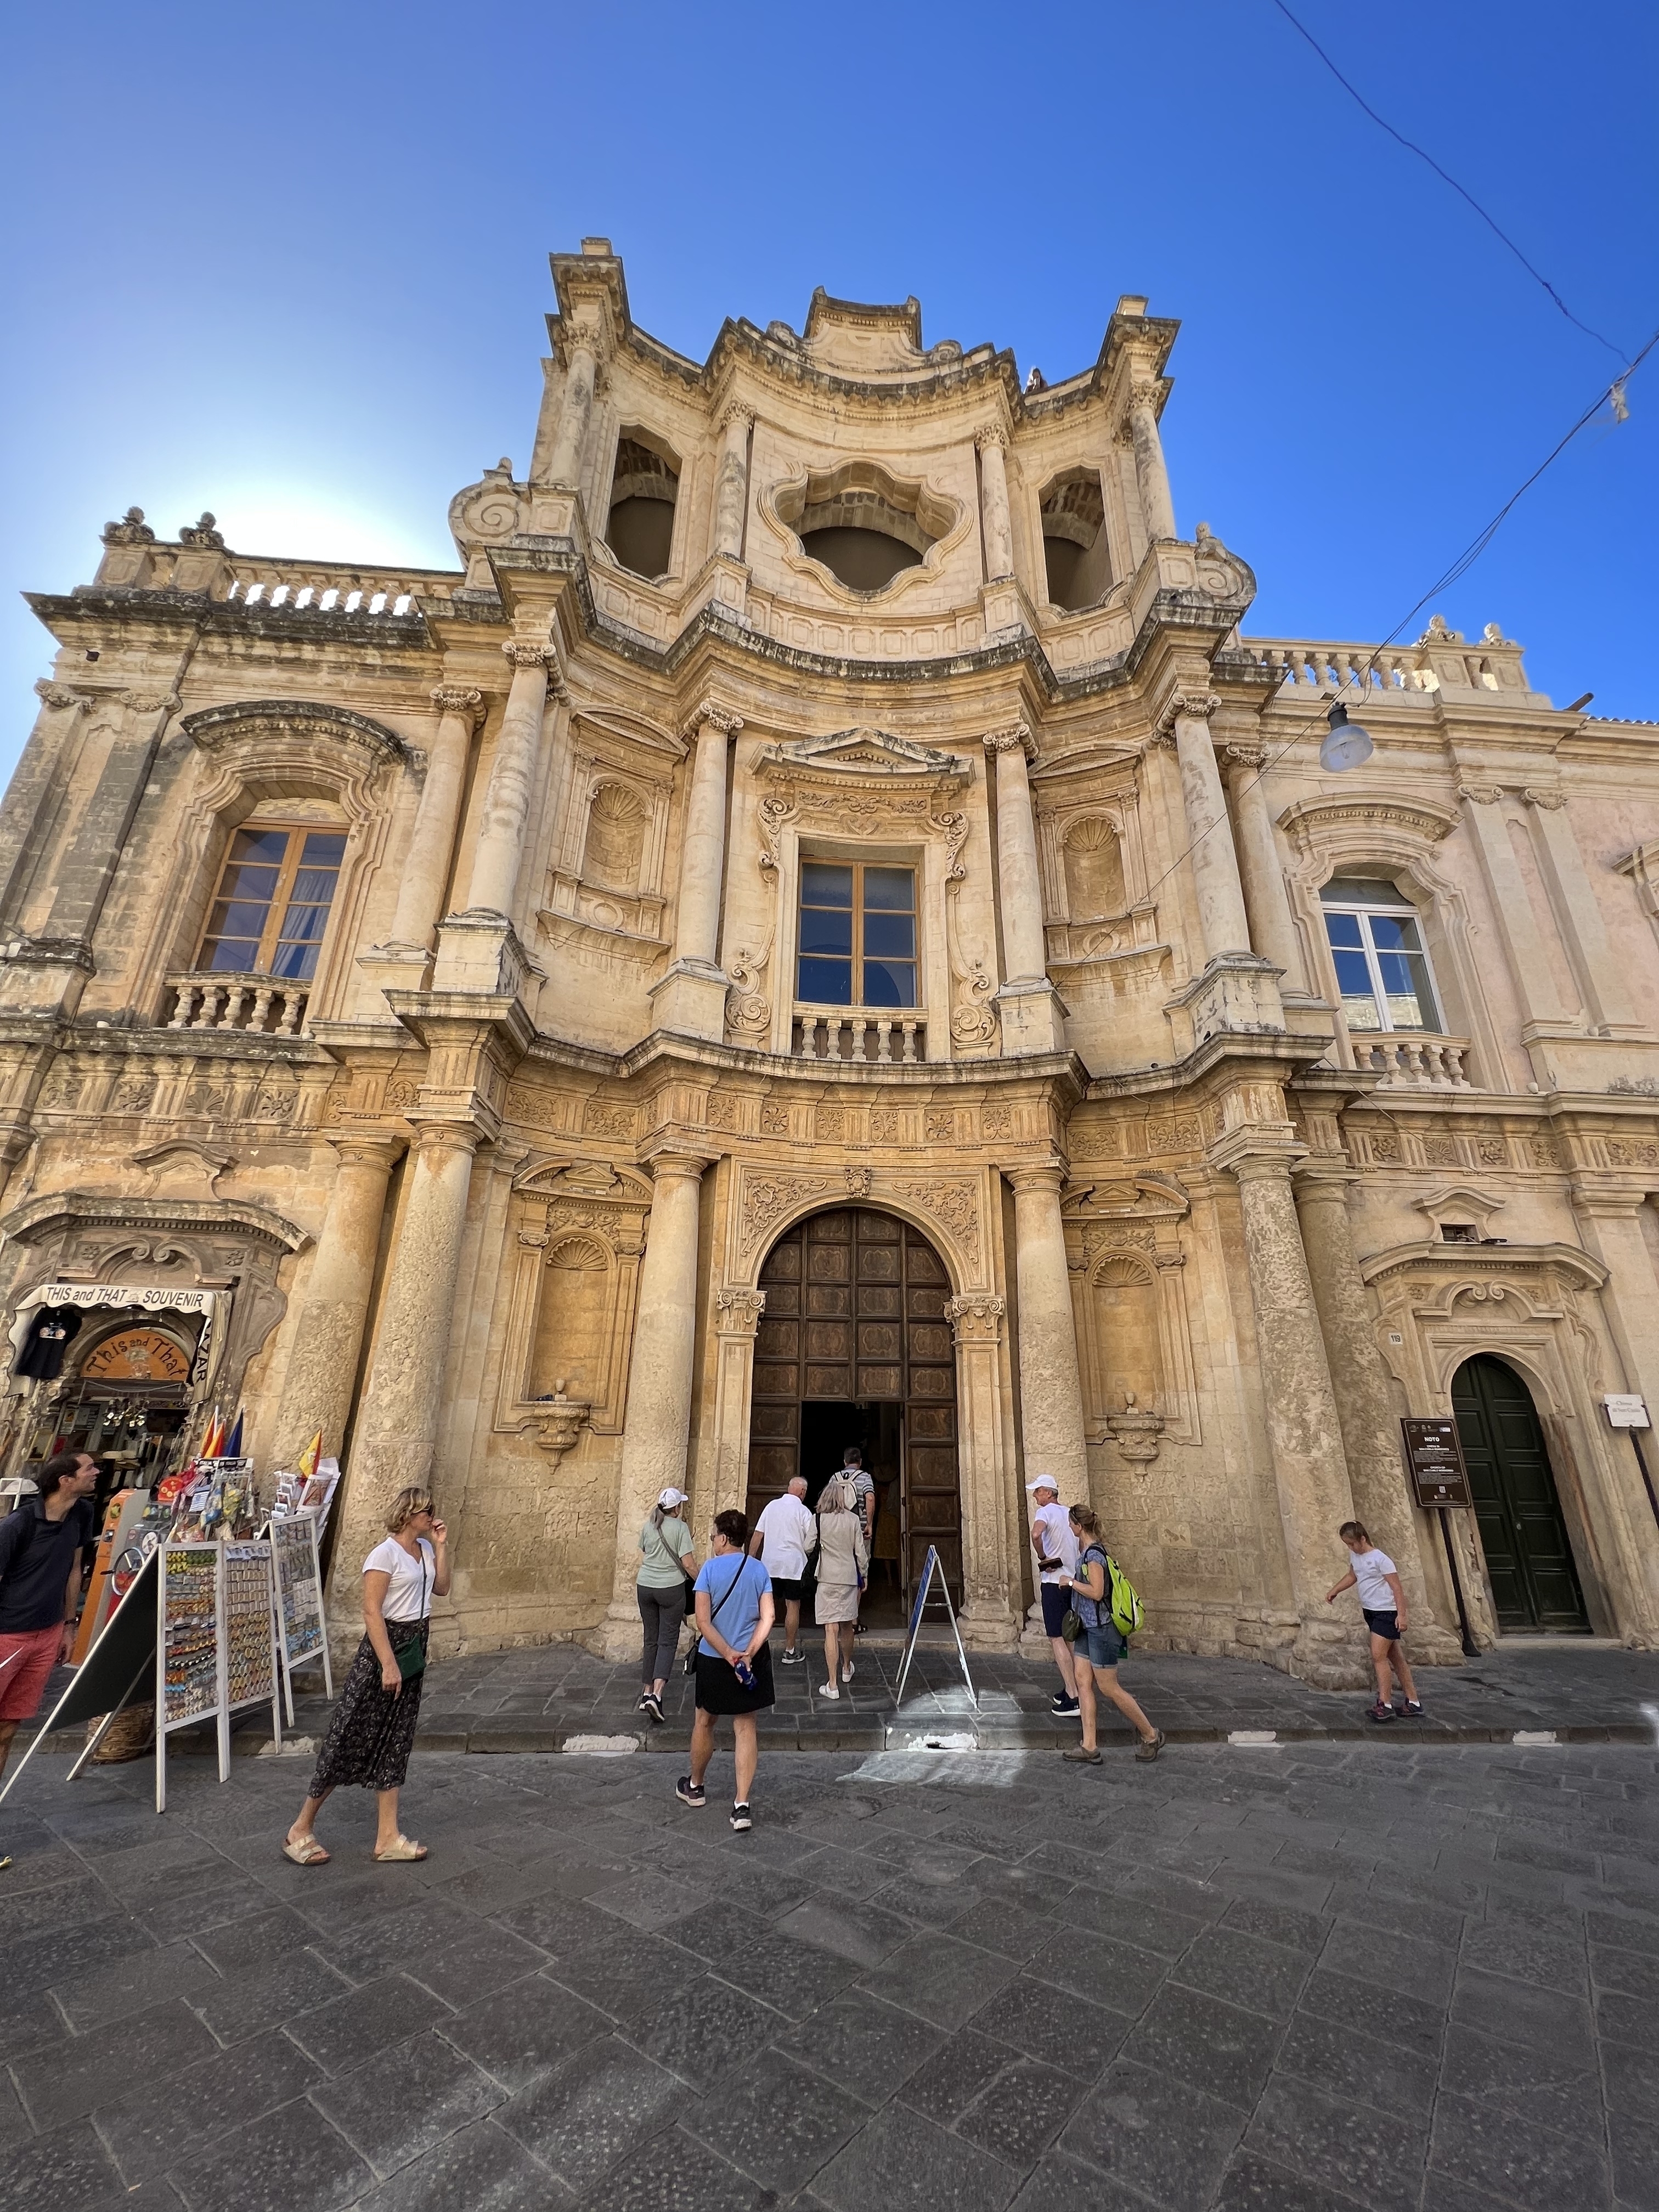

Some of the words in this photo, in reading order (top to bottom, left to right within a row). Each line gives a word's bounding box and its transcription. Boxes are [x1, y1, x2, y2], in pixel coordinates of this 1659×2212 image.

[47, 1287, 72, 1301] THIS
[72, 1288, 95, 1301] and
[96, 1289, 128, 1302] THAT
[143, 1290, 204, 1307] SOUVENIR
[86, 1341, 128, 1372] This
[129, 1337, 150, 1347] and
[151, 1338, 189, 1376] That
